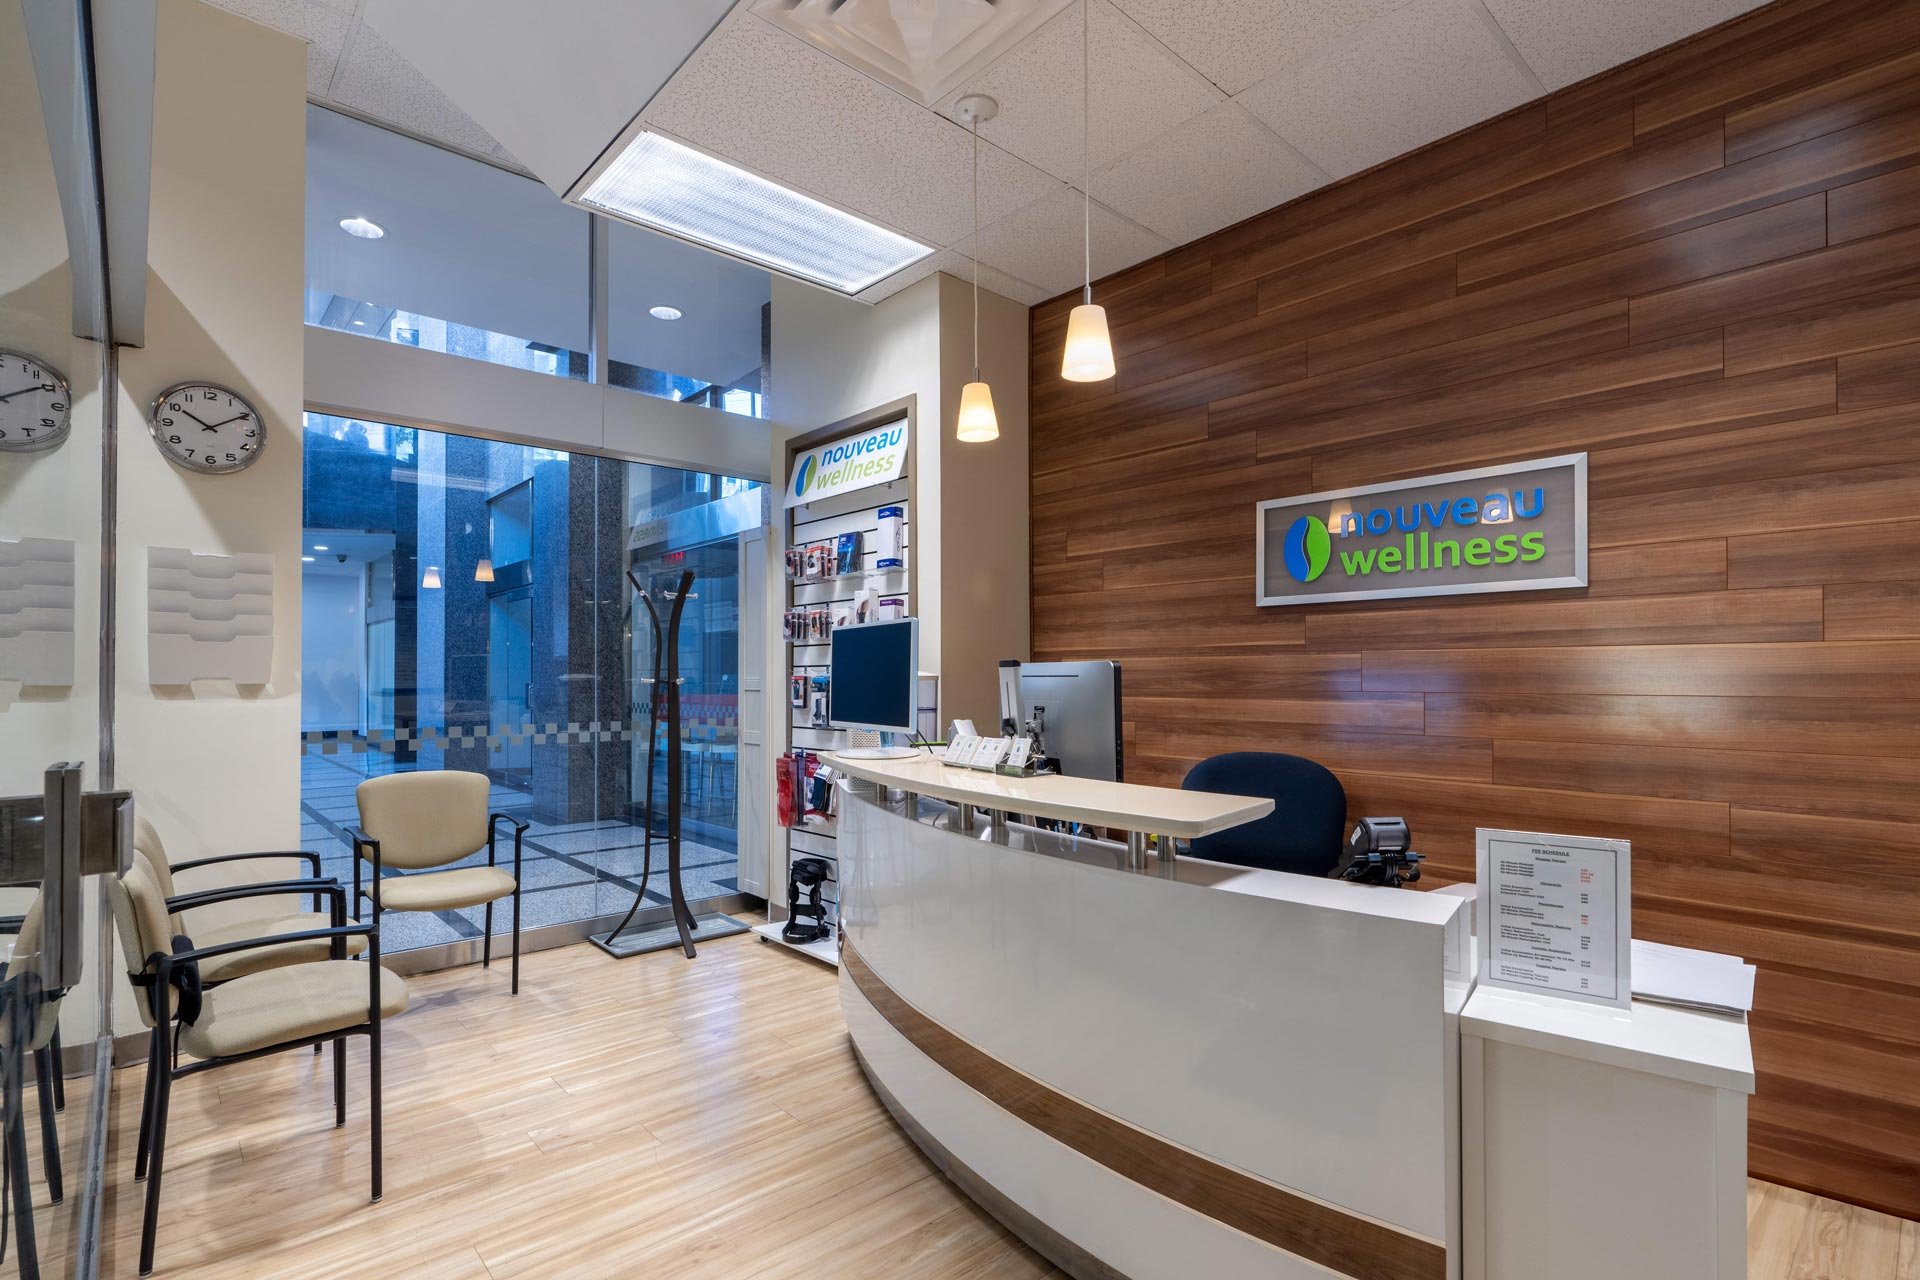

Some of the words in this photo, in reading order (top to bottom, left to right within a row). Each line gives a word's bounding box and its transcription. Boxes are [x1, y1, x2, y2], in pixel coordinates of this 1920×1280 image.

[185, 393, 193, 403] 11
[203, 391, 218, 401] 12
[169, 402, 181, 412] 10
[161, 417, 174, 426] 9
[239, 412, 250, 421] 2
[245, 429, 256, 438] 3
[169, 435, 182, 444] 8
[240, 443, 250, 452] 4
[821, 428, 902, 467] nouveau
[185, 448, 195, 458] 7
[225, 453, 237, 462] 5
[205, 455, 217, 464] 6
[817, 454, 895, 490] wellness
[1340, 487, 1545, 538] nouveau
[1340, 531, 1546, 576] wellness
